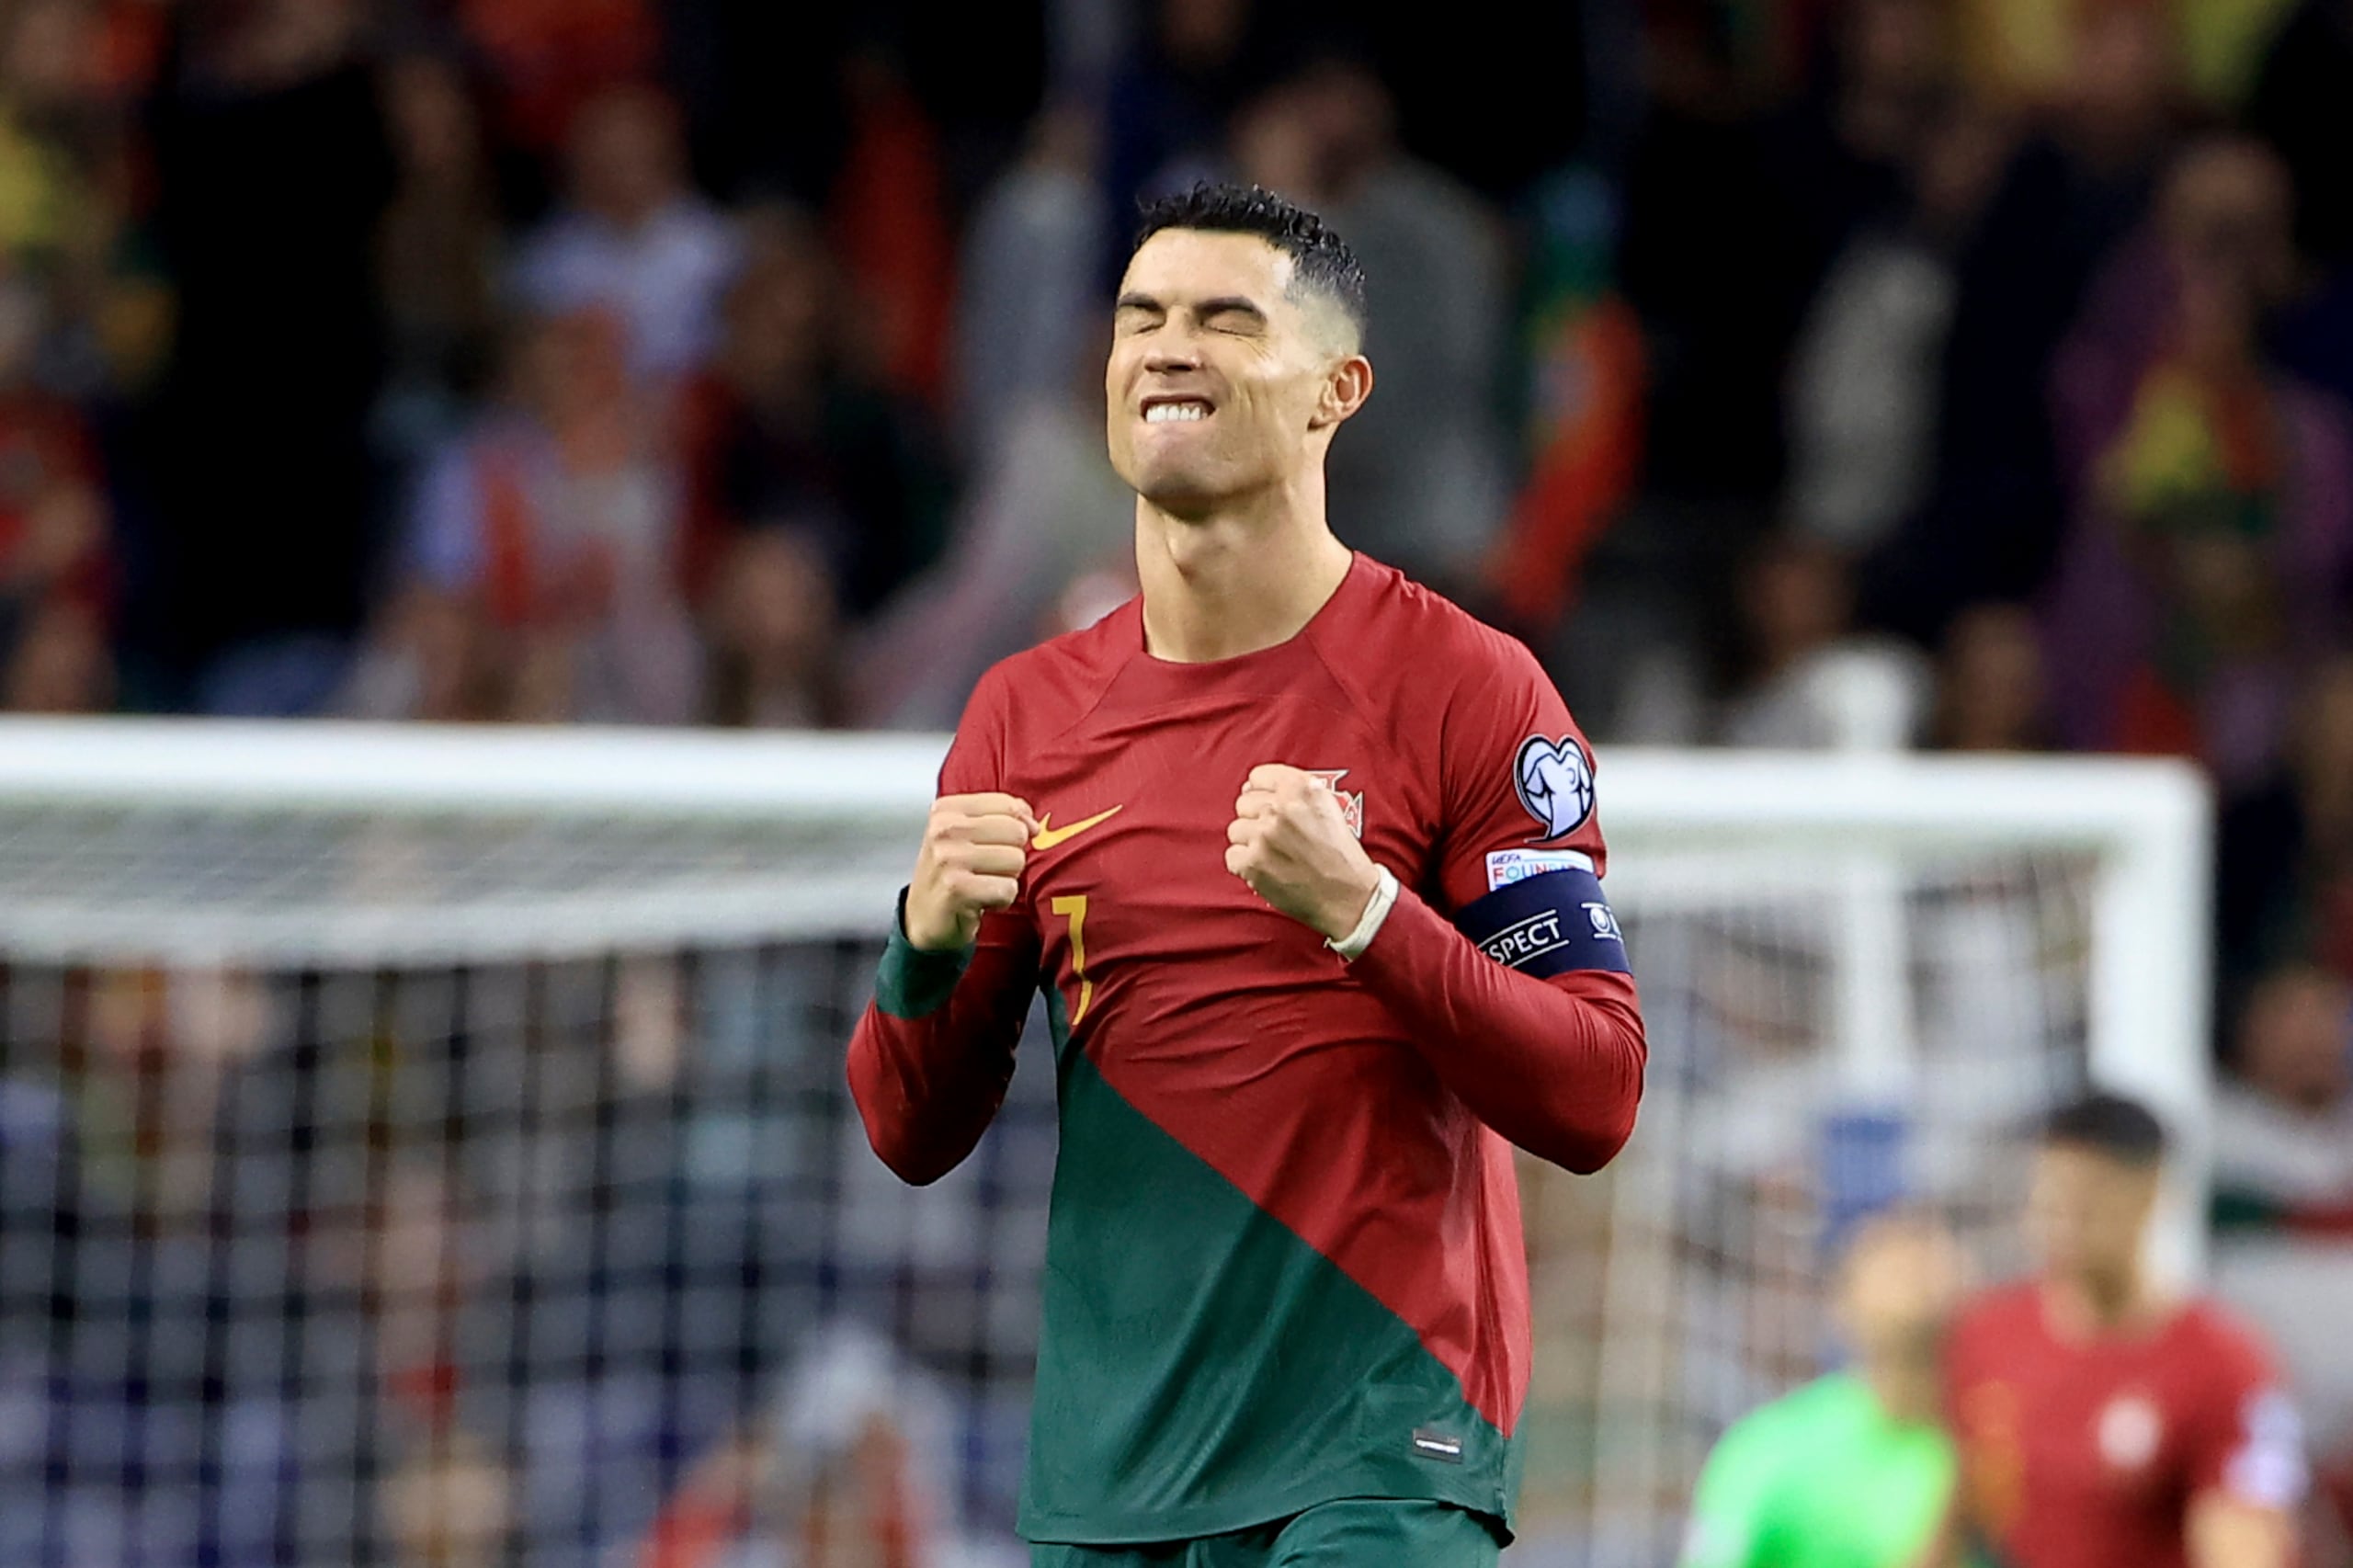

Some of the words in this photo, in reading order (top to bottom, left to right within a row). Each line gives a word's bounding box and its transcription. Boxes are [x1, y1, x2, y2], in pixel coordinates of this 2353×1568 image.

[1492, 853, 1521, 864] UEFA
[1051, 895, 1093, 1026] 7
[1483, 917, 1560, 965] SPECT
